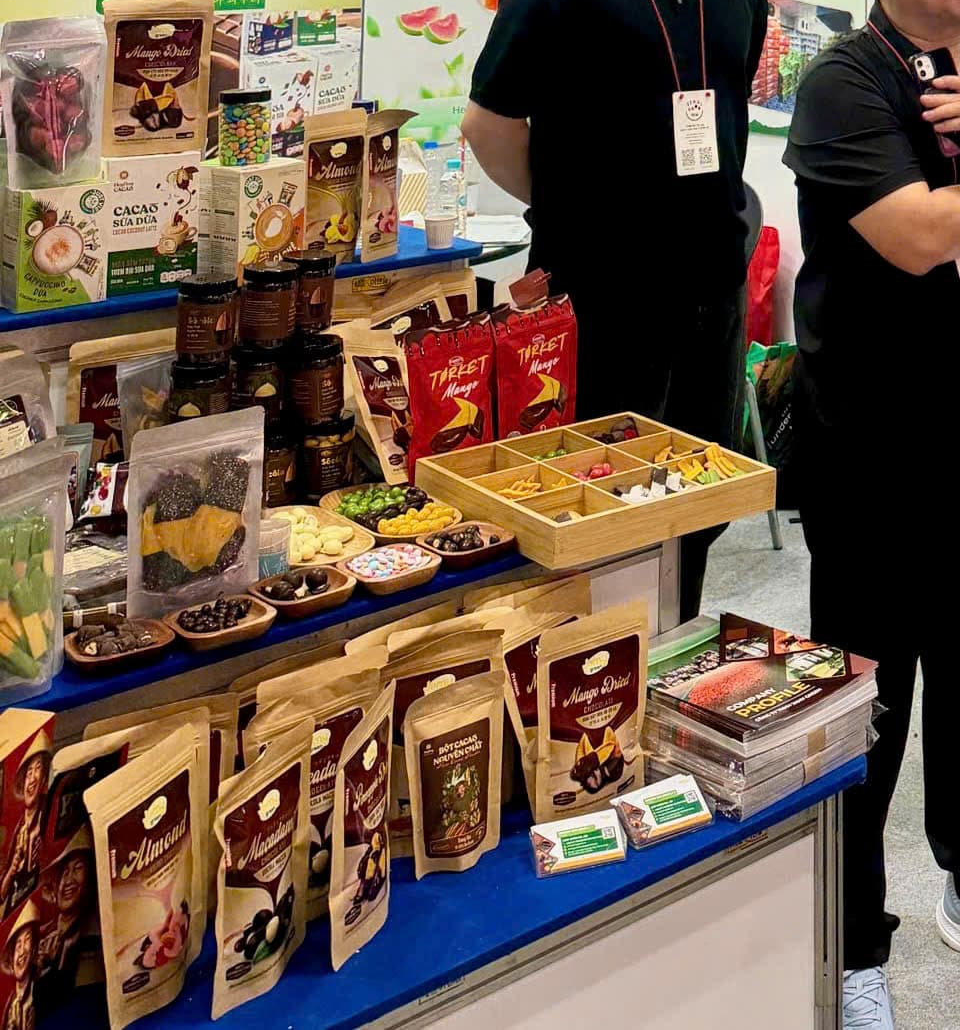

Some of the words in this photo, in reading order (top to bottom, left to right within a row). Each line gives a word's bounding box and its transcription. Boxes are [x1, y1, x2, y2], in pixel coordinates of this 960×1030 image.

[113, 203, 159, 217] CACAO
[528, 356, 560, 377] Mango
[441, 380, 480, 402] Mango
[563, 682, 599, 709] Mango
[600, 671, 632, 695] Dried
[726, 687, 777, 712] COMPANY
[735, 681, 811, 718] PROFILE
[120, 809, 188, 880] Almond
